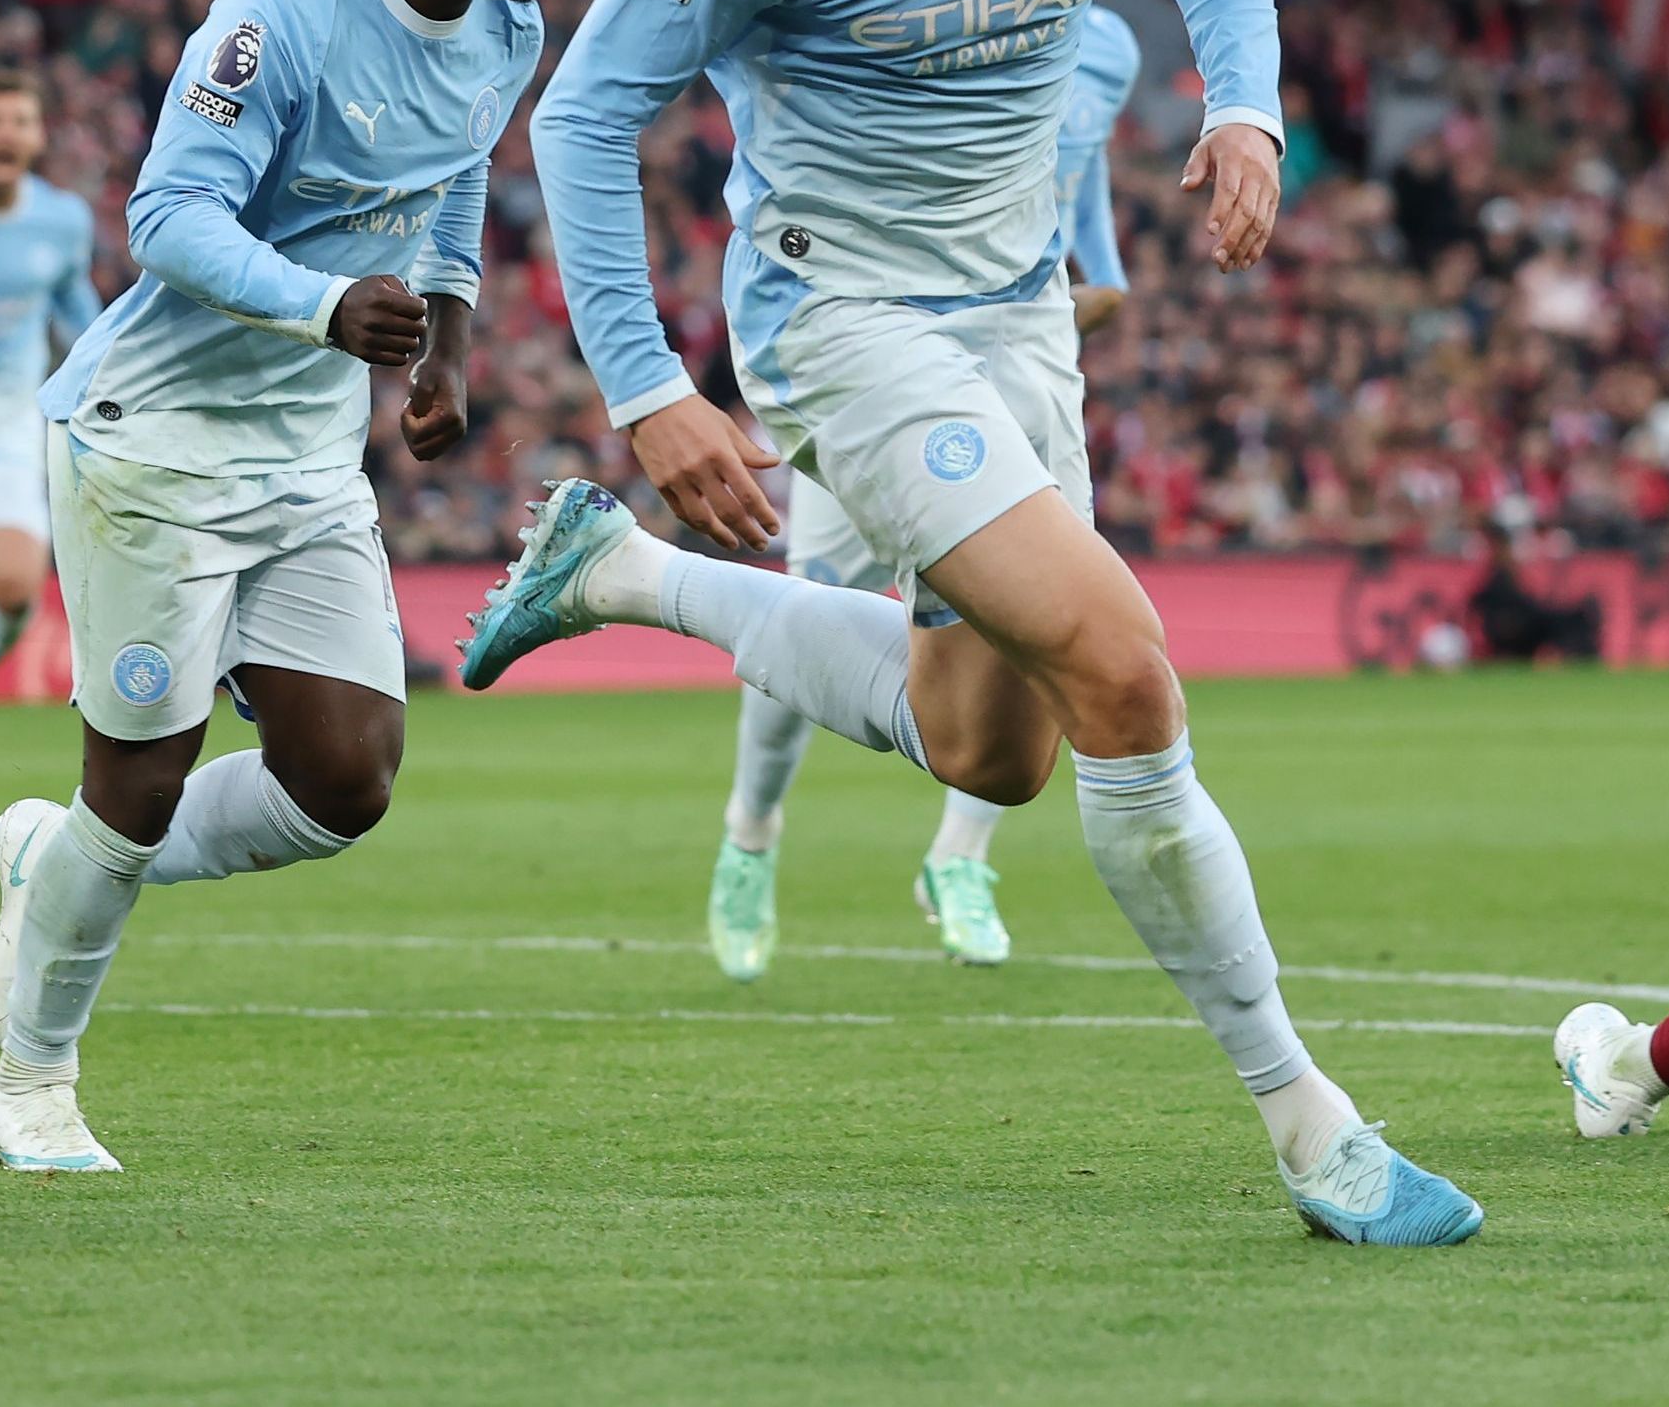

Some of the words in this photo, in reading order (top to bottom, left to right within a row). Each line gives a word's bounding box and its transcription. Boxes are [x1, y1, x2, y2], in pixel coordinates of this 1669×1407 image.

[912, 18, 1069, 78] AIRWAYS
[192, 101, 237, 129] racism
[198, 90, 237, 116] room
